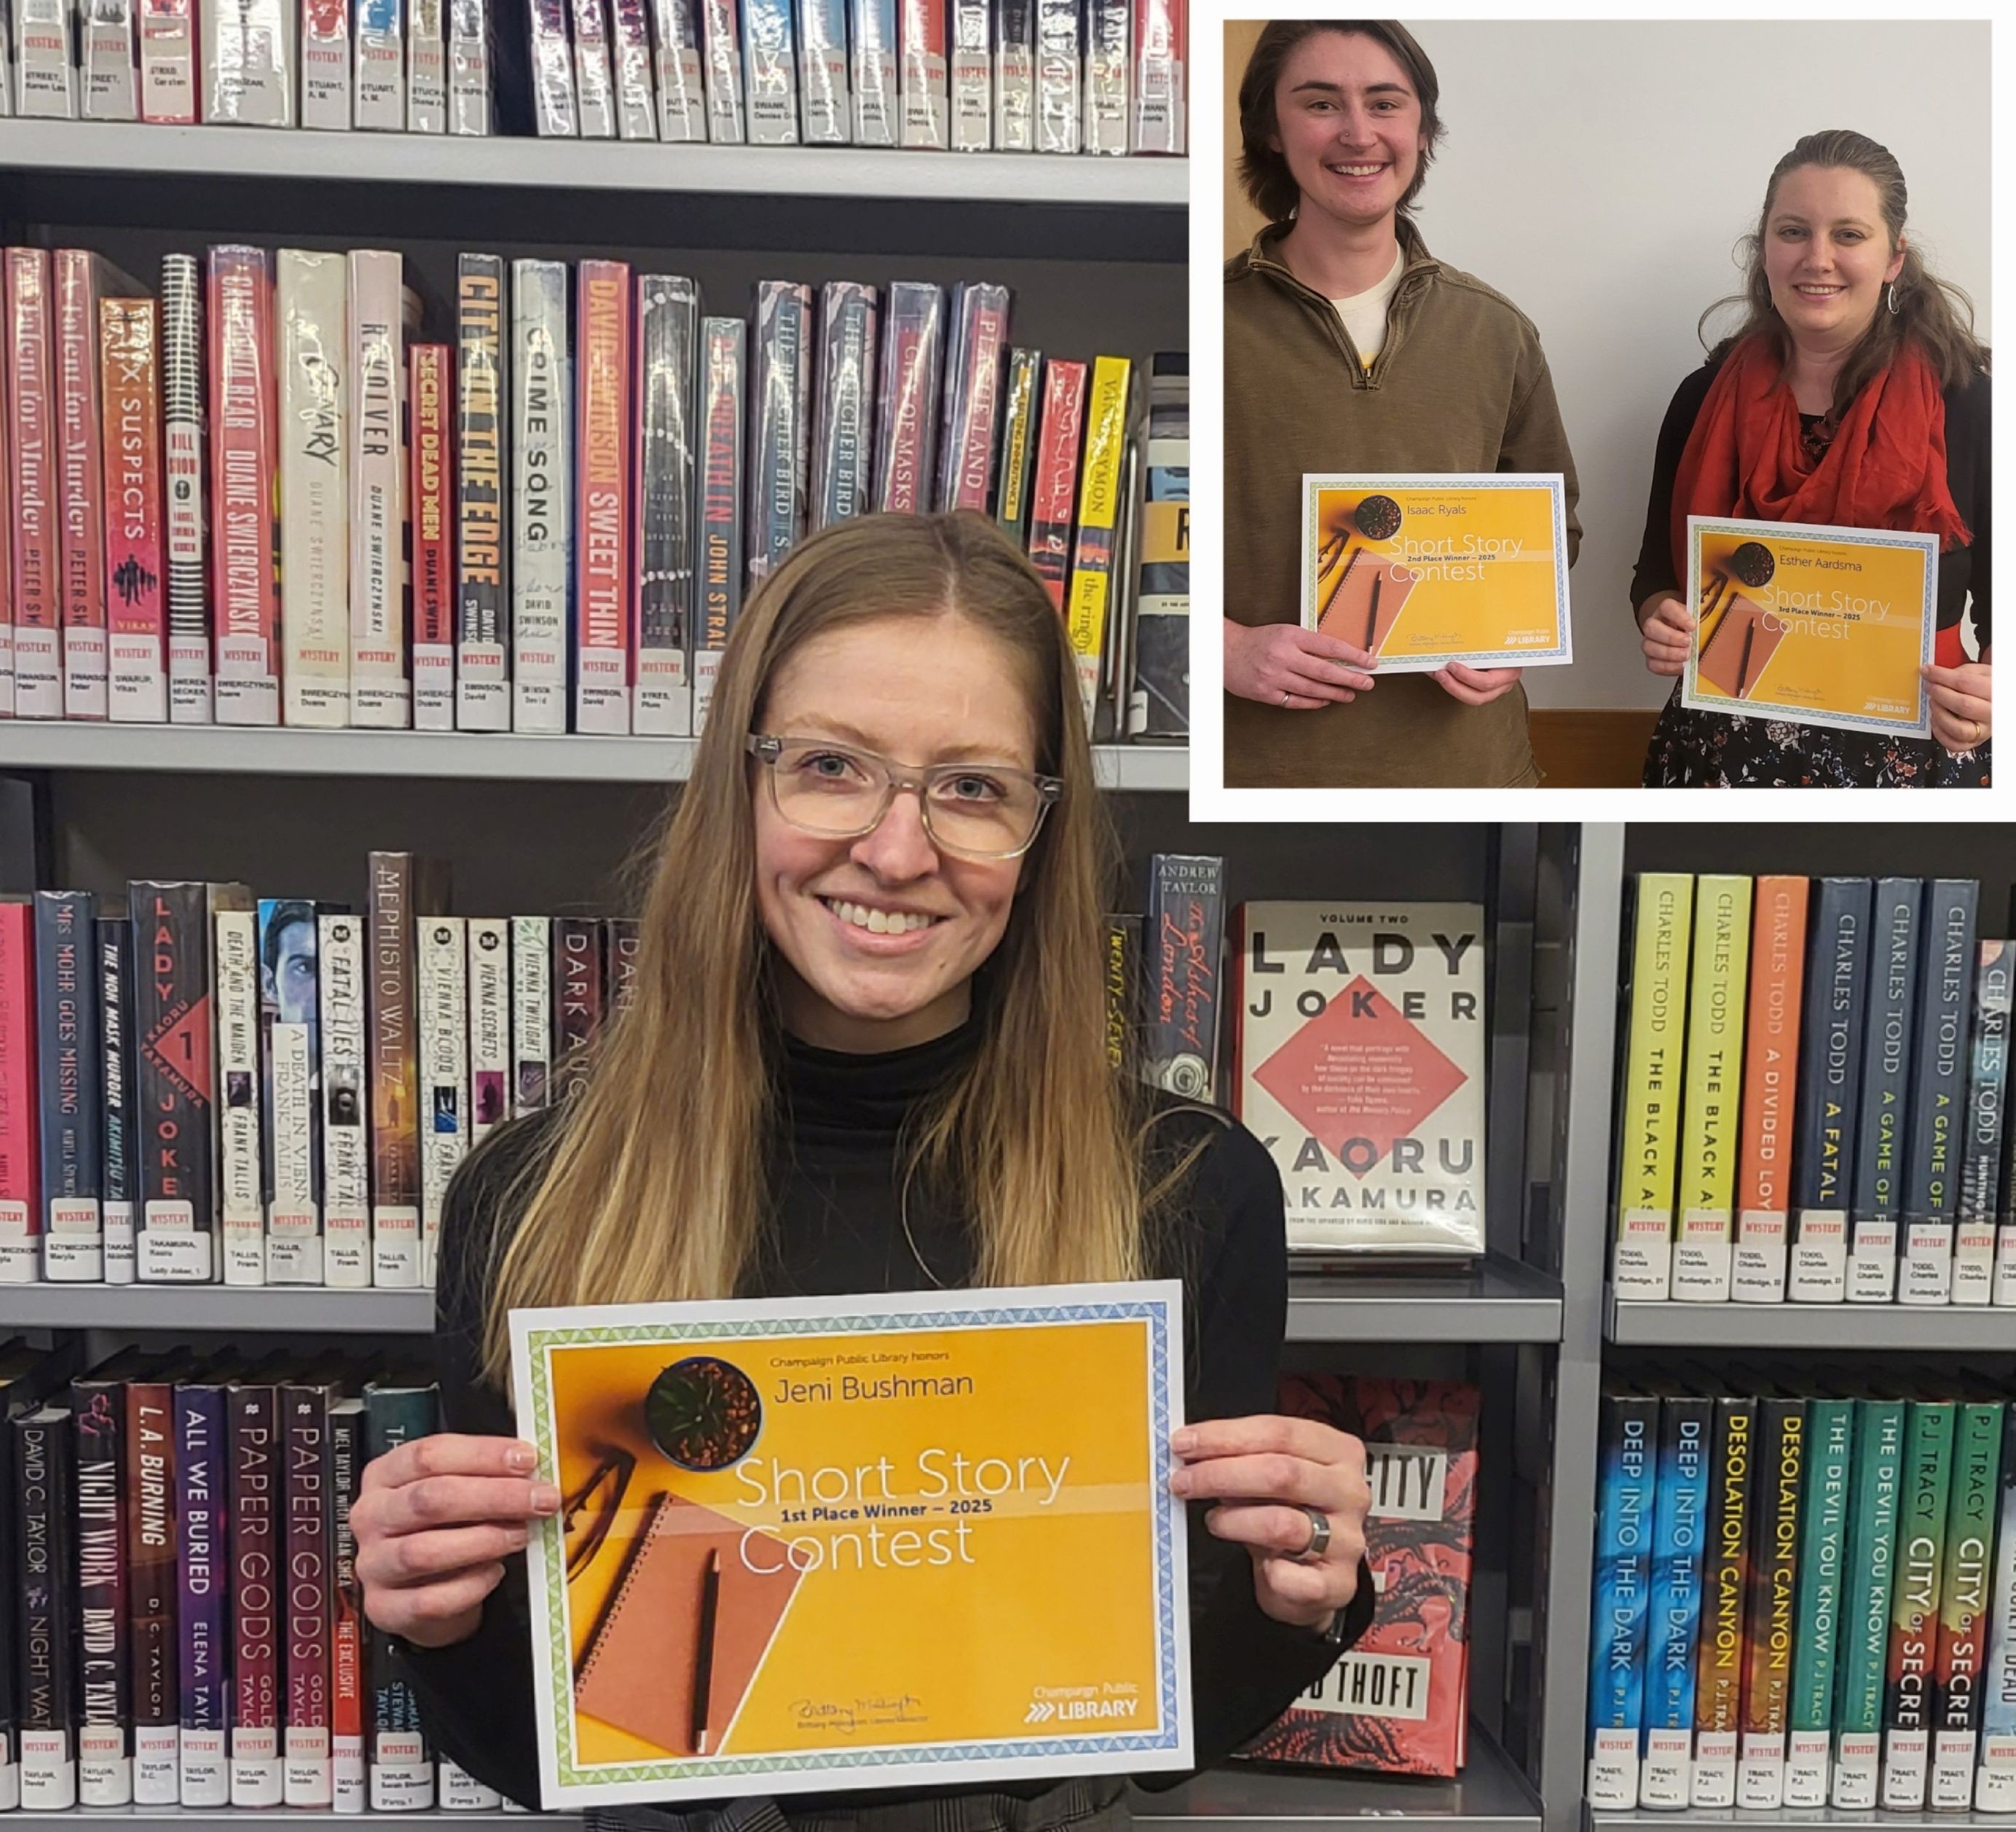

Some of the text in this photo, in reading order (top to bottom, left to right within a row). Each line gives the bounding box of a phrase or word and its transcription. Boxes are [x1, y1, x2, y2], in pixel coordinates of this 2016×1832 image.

[460, 275, 498, 350] CITY
[119, 396, 145, 540] SUSPECTS
[420, 353, 441, 542] SECRET DEAD MEN
[462, 428, 500, 495] THE
[526, 326, 550, 543] CRIME SONG
[894, 403, 919, 510] OF MASKS
[461, 500, 500, 586] EDGE
[588, 491, 620, 579] SWEET
[1407, 505, 1466, 516] Isaac Ryals
[706, 535, 728, 585] JOHN
[1390, 534, 1524, 559] Short Story
[1390, 562, 1486, 583] Contest
[1780, 555, 1862, 572] Esther Aardsma
[518, 616, 559, 626] SWINSON
[524, 599, 552, 610] DAVID
[1762, 611, 1850, 640] Contest
[1763, 583, 1891, 621] Short Story
[1811, 610, 1835, 618] Winner
[520, 653, 555, 664] MYSTERY
[1518, 636, 1551, 644] LIBRARY
[1877, 704, 1910, 715] LIBRARY
[1158, 865, 1219, 879] ANDREW
[1165, 881, 1217, 895] TAYLOR
[1320, 913, 1409, 924] VOLUME TWO
[57, 944, 76, 995] MOHR
[375, 866, 403, 1090] MEPHISTO WALTZ
[564, 933, 589, 1017] DARK
[1252, 931, 1476, 976] LADY
[58, 999, 77, 1042] GOES
[148, 999, 189, 1039] KAORU
[227, 930, 248, 1066] DEATH AND THE MAIDEN
[331, 957, 353, 1057] FATAL LIES
[522, 952, 543, 1053] VIENNA TWILIGHT
[1249, 989, 1477, 1021] JOKER
[1759, 892, 1789, 1160] CHARLES TODD A DIVIDED
[103, 943, 124, 1179] THE NOH MASK MURDER AKIMITSU
[1640, 890, 1675, 1177] CHARLES TODD THE BLACK
[1701, 892, 1734, 1179] CHARLES TODD THE BLACK
[1819, 913, 1856, 1203] CHARLES TODD A FATAL
[1875, 903, 1911, 1206] CHARLES TODD A GAME OF
[1977, 968, 2007, 1145] CHARLES TODD
[58, 1047, 78, 1114] MISSING
[232, 1113, 250, 1200] FRANK TALLIS
[277, 1061, 292, 1189] FRANK TALLIS
[275, 1214, 313, 1227] MYSTERY
[377, 1218, 416, 1229] MYSTERY
[1618, 1258, 1650, 1267] Charles
[1619, 1250, 1645, 1260] TODD,
[770, 1351, 949, 1369] Champaign Public Library honors
[773, 1374, 973, 1404] Jeni Bushman
[24, 1429, 47, 1574] DAVID C. TAYLOR
[138, 1406, 166, 1547] L.A. BURNING
[185, 1410, 211, 1596] ALL WE BURIED
[735, 1448, 1071, 1507] Short Story
[781, 1498, 993, 1522] 1st Place Winner 2025
[79, 1460, 119, 1589] NIGHT WORK
[238, 1428, 272, 1661] PAPER GODS
[739, 1519, 976, 1574] Contest
[1610, 1420, 1645, 1671] DEEP INTO THE DARK
[1714, 1415, 1749, 1668] DESOLATION CANYON
[1769, 1416, 1802, 1670] DESOLATION CANYON
[1814, 1413, 1847, 1654] THE DEVIL YOU KNOW
[1866, 1416, 1898, 1655] THE DEVIL YOU KNOW
[1907, 1452, 1937, 1634] TRACY CITY OF
[1956, 1452, 1988, 1635] TRACY CITY OF
[334, 1428, 355, 1699] MEL TAYLOR THE EXCLUSIVE
[192, 1621, 209, 1678] ELENA
[1033, 1682, 1138, 1699] Champaign Public
[1058, 1699, 1138, 1720] LIBRARY
[1338, 1661, 1418, 1709] THOFT
[141, 1739, 176, 1750] MYSTERY
